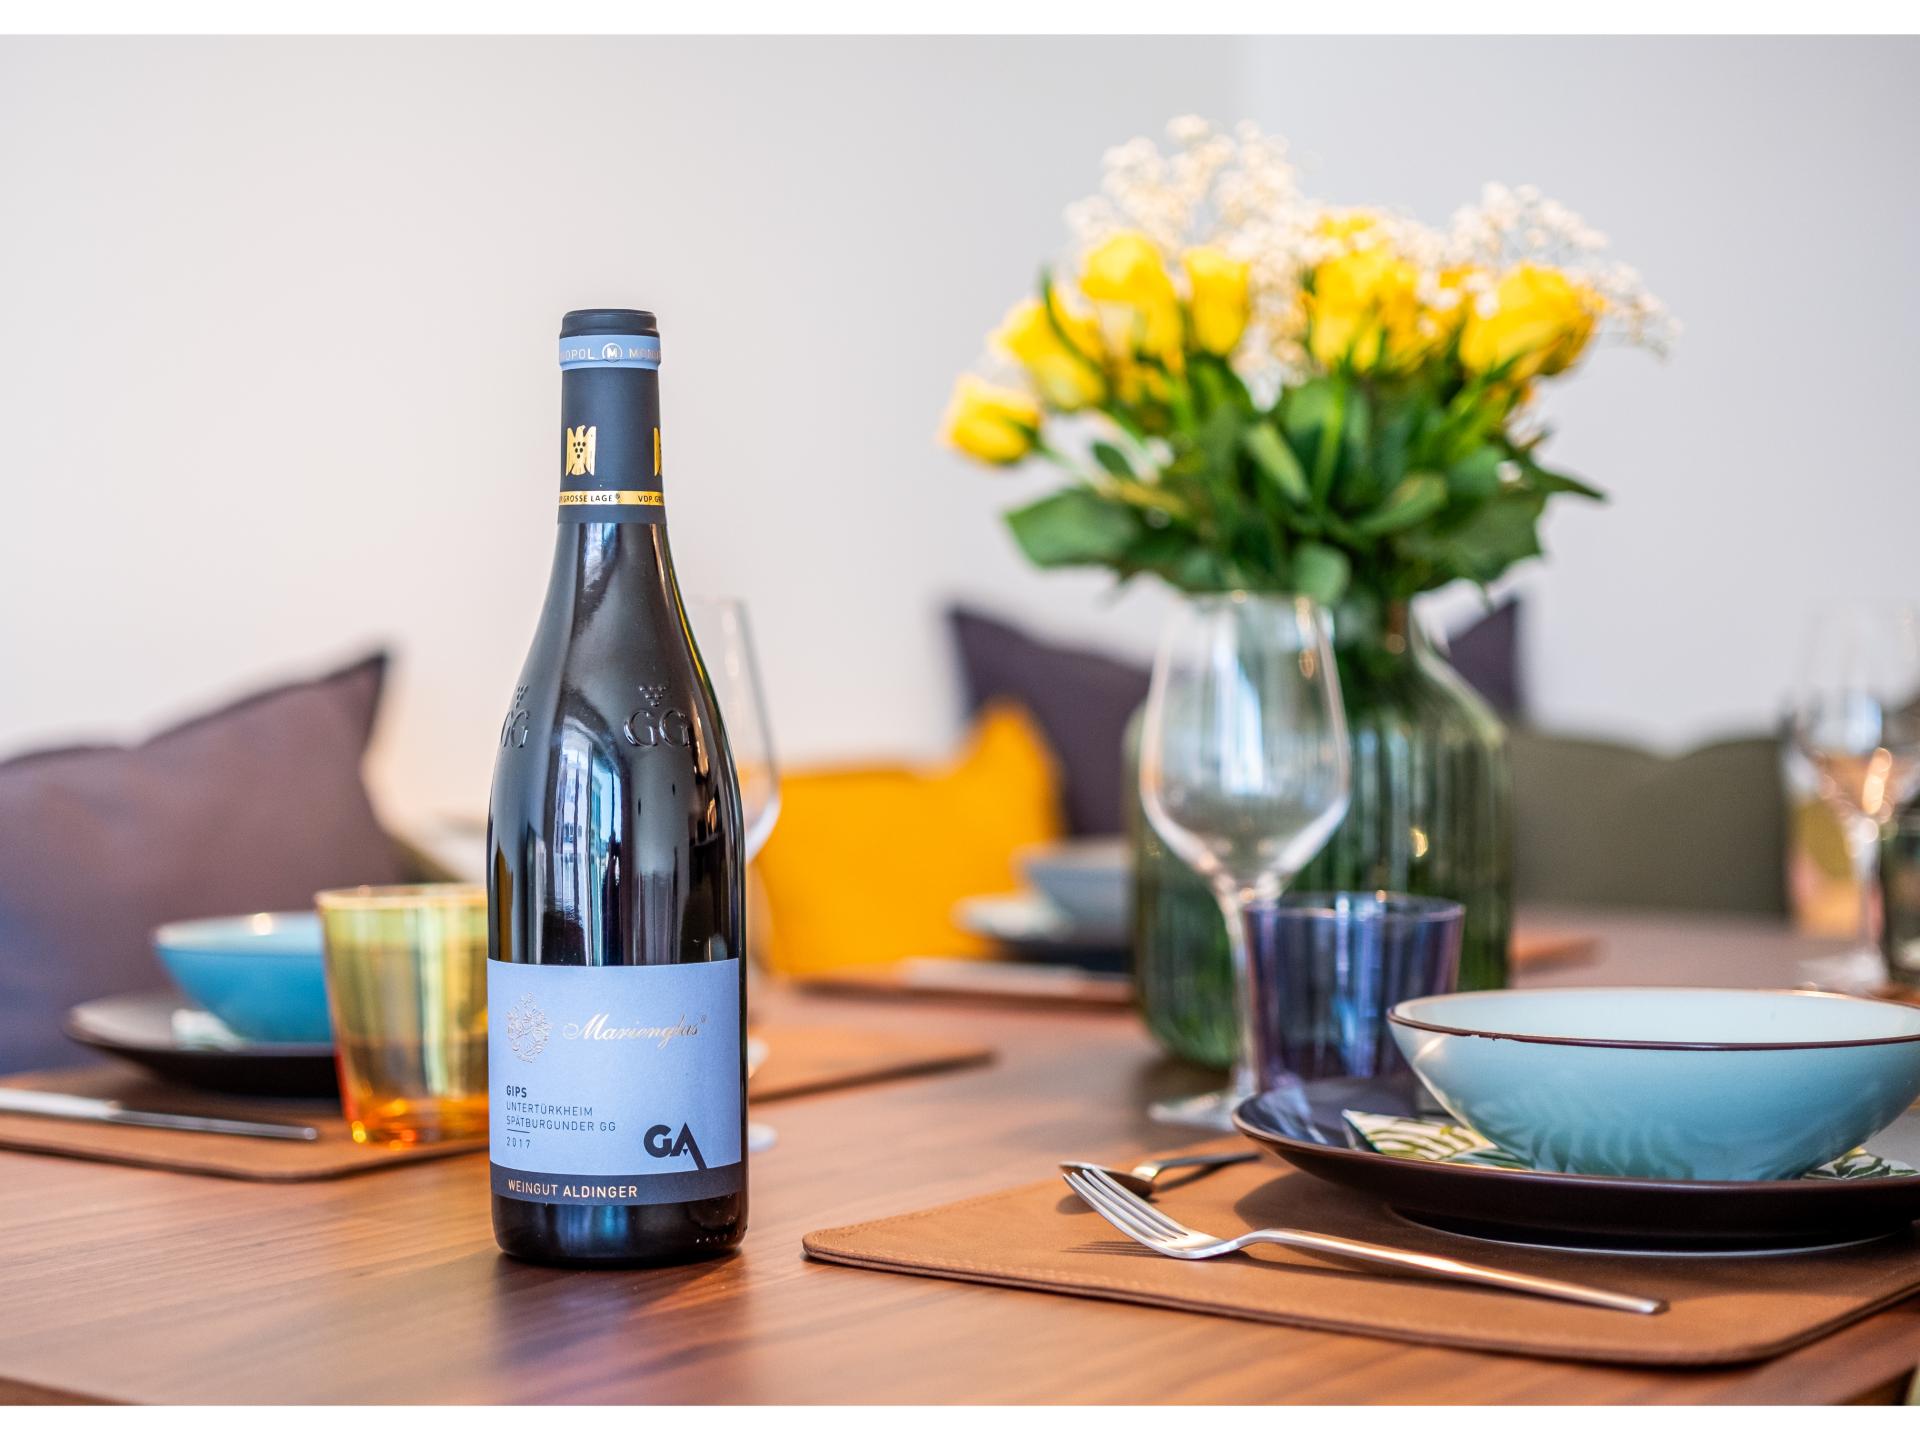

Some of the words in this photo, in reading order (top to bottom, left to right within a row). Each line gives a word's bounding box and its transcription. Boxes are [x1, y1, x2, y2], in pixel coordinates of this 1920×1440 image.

[590, 494, 613, 503] LAGE
[506, 1085, 527, 1098] GIPS
[600, 1122, 616, 1132] GG
[506, 1136, 531, 1149] 2017
[643, 1122, 707, 1169] GA
[508, 1179, 558, 1196] WEINGUT
[562, 1185, 638, 1198] ALDINGER
